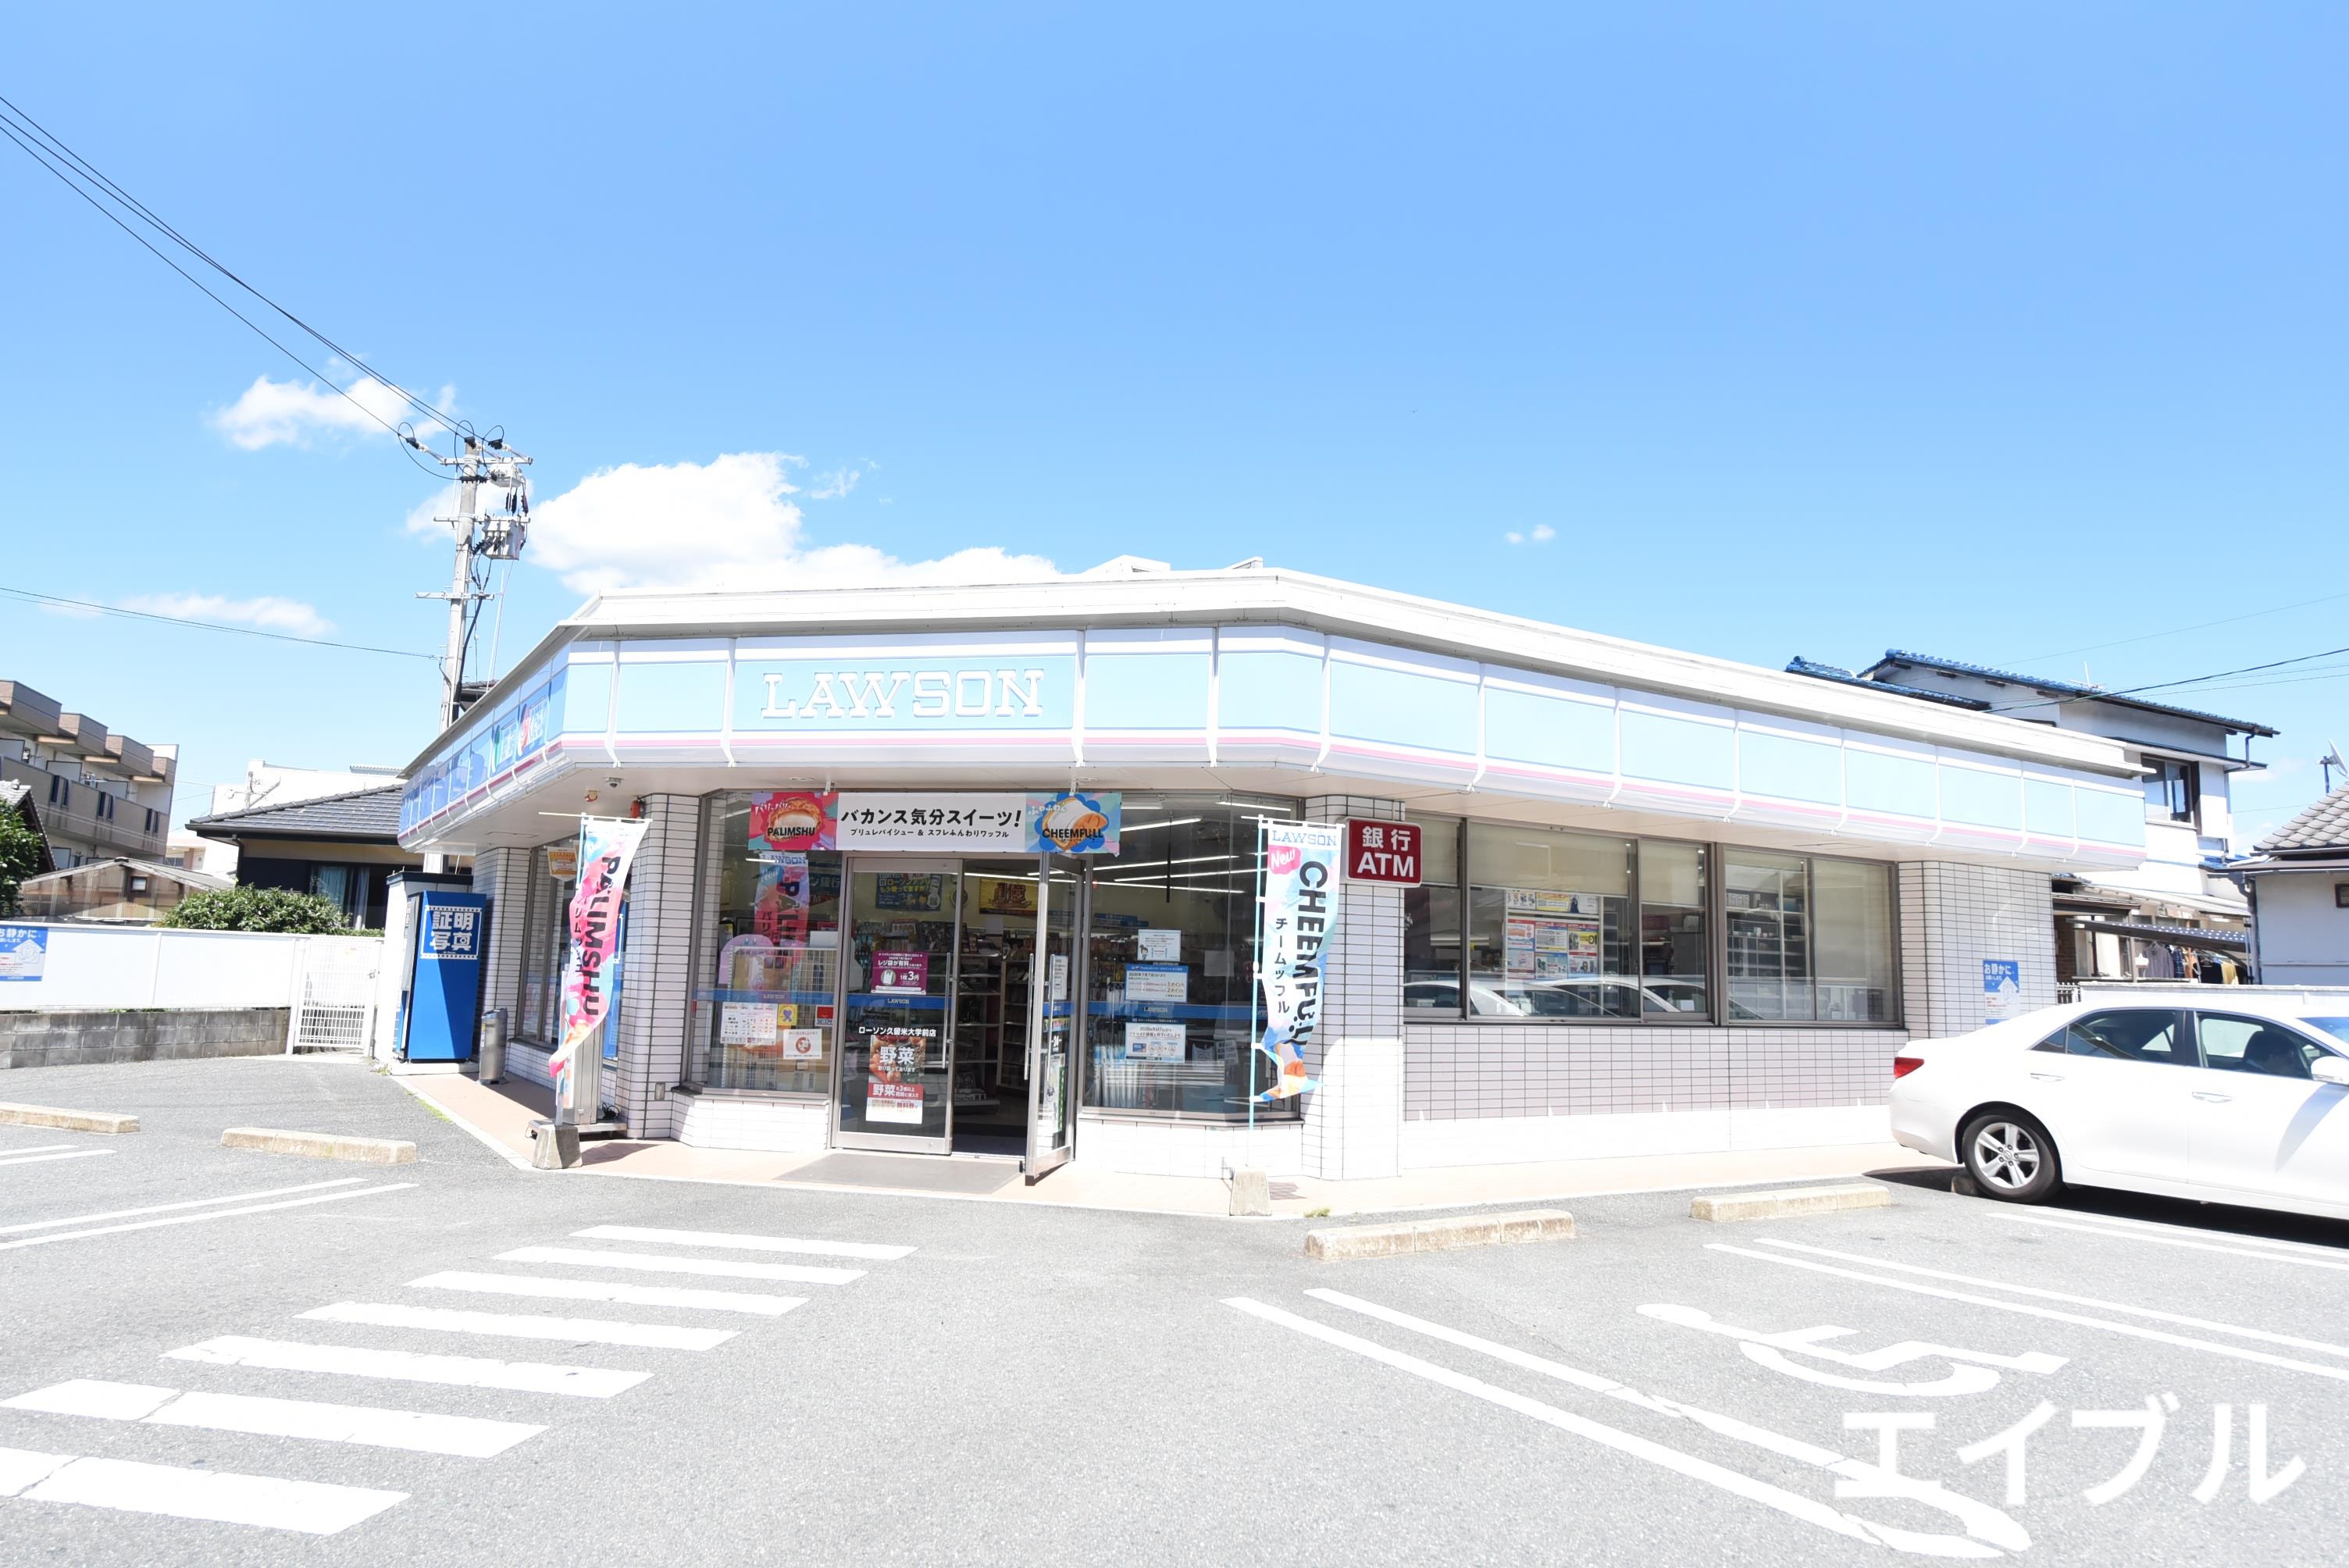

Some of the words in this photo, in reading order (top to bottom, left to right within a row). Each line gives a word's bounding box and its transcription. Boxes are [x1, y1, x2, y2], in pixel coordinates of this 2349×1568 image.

[761, 668, 1044, 718] LAWSON
[841, 807, 1021, 828] バカンス気分スイーツ!
[767, 827, 816, 836] PALIMSHU
[1042, 828, 1103, 840] CHEEMFULL
[1272, 830, 1337, 846] LAWSON
[1362, 825, 1412, 852] 銀行
[1271, 848, 1296, 870] New
[1356, 850, 1414, 878] ATM
[432, 911, 474, 931] 証明
[430, 931, 472, 951] 写真
[583, 856, 621, 1016] PALIMSHU
[1274, 918, 1290, 1014] チームッフル
[859, 1026, 937, 1037] ローソン久留米大学前店
[879, 1046, 915, 1065] 野菜
[872, 1084, 896, 1096] 野菜
